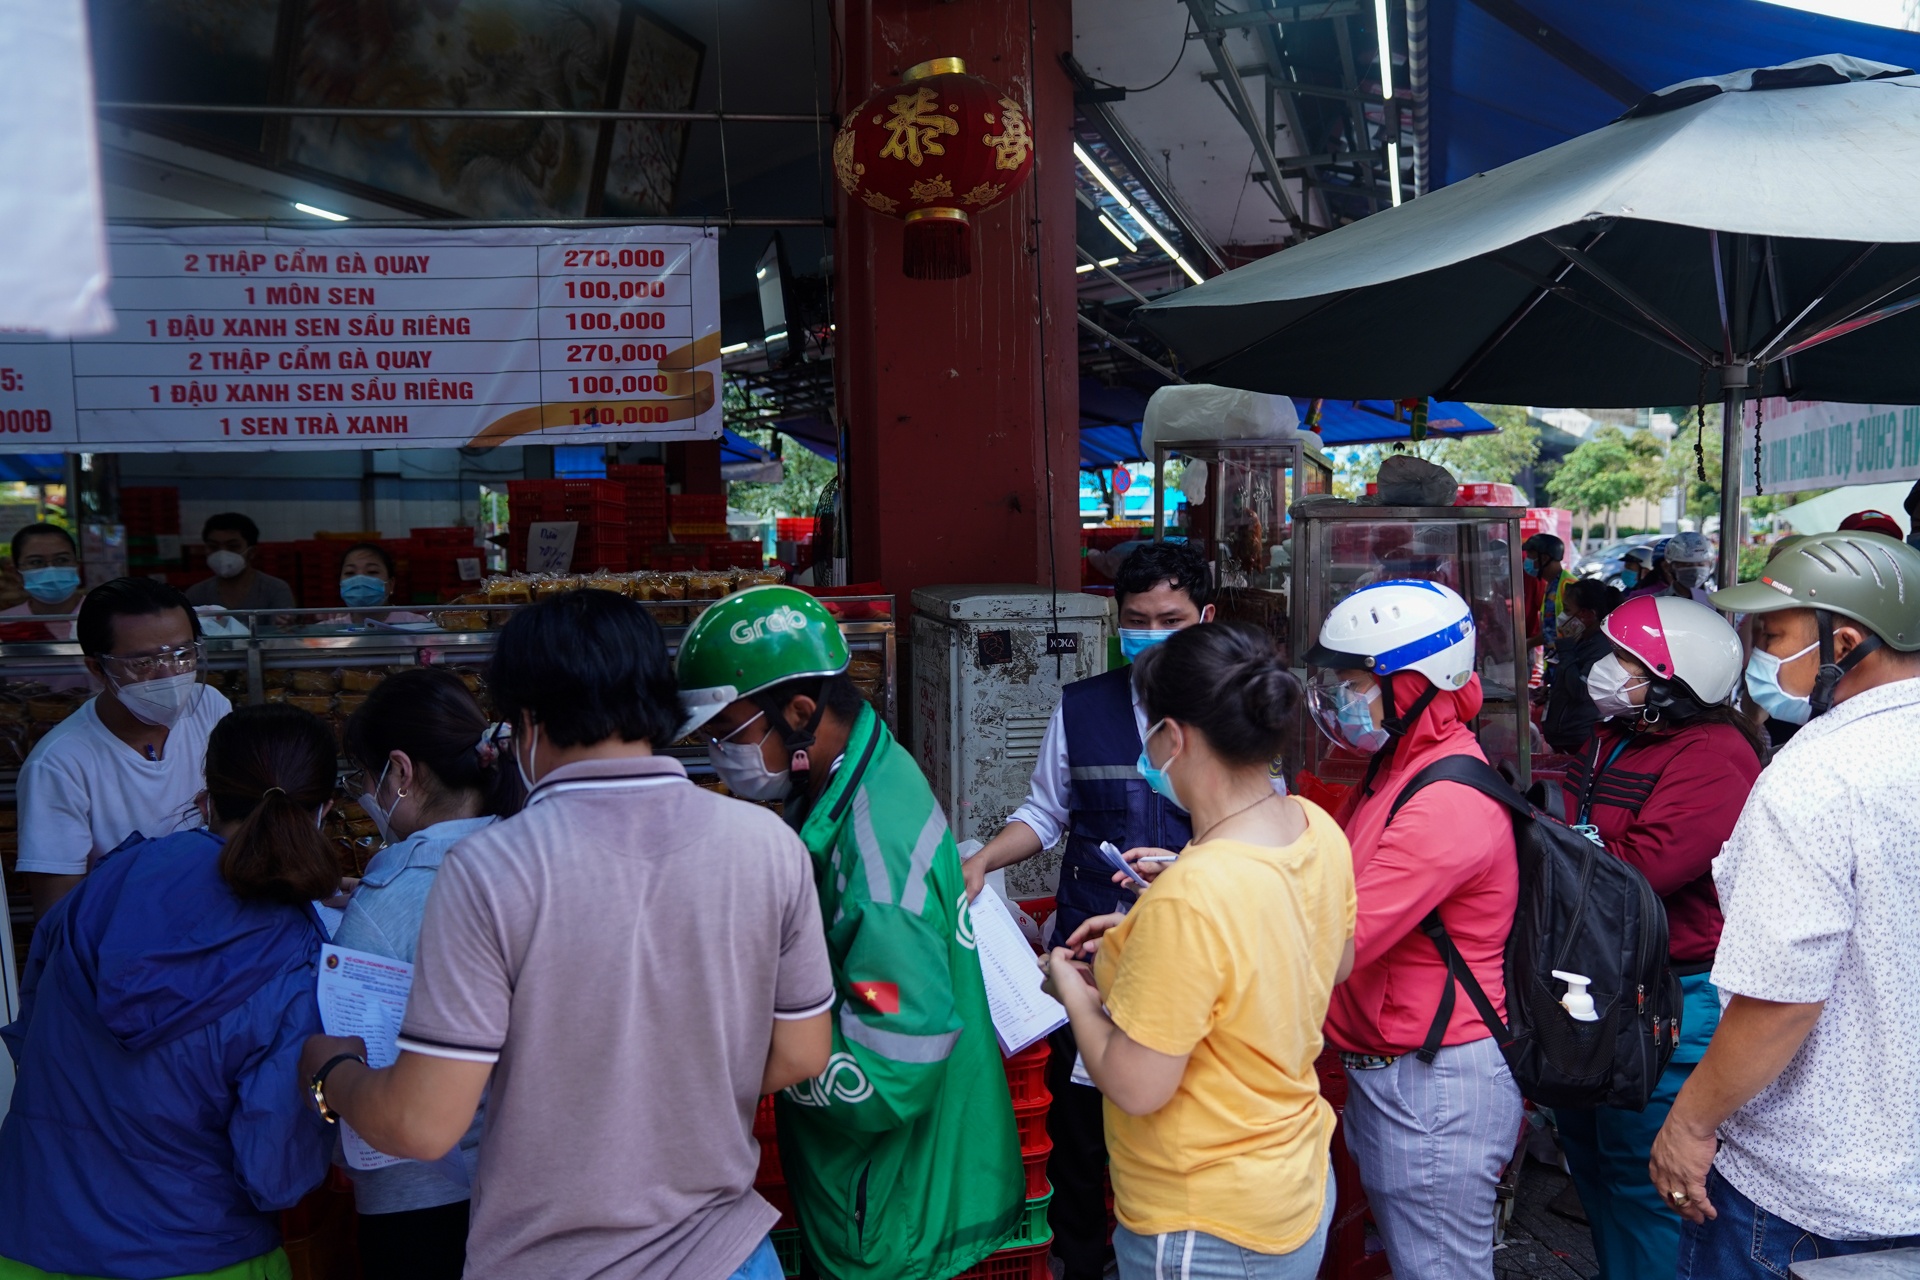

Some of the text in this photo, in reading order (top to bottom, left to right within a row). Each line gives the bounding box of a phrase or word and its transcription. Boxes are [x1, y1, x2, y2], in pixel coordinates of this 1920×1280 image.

[879, 87, 959, 167] 恭
[184, 247, 430, 277] 2 THẬP CẨM GÀ QUAY
[563, 249, 666, 269] 270,000
[244, 282, 375, 305] 1 MÔN SEN
[564, 280, 666, 301] 100,000
[146, 311, 472, 341] 1 ĐẬU XANH SEN SẦU RIÊNG
[565, 312, 666, 332] 100,000
[189, 344, 432, 374] 2 THẬP CẨM GÀ QUAY
[566, 343, 668, 364] 270,000
[149, 376, 474, 407] 1 ĐẬU XANH SEN SẦU RIÊNG
[568, 374, 669, 396] 100,000
[220, 412, 408, 436] 1 SEN TRÀ XANH
[730, 605, 807, 645] Grab
